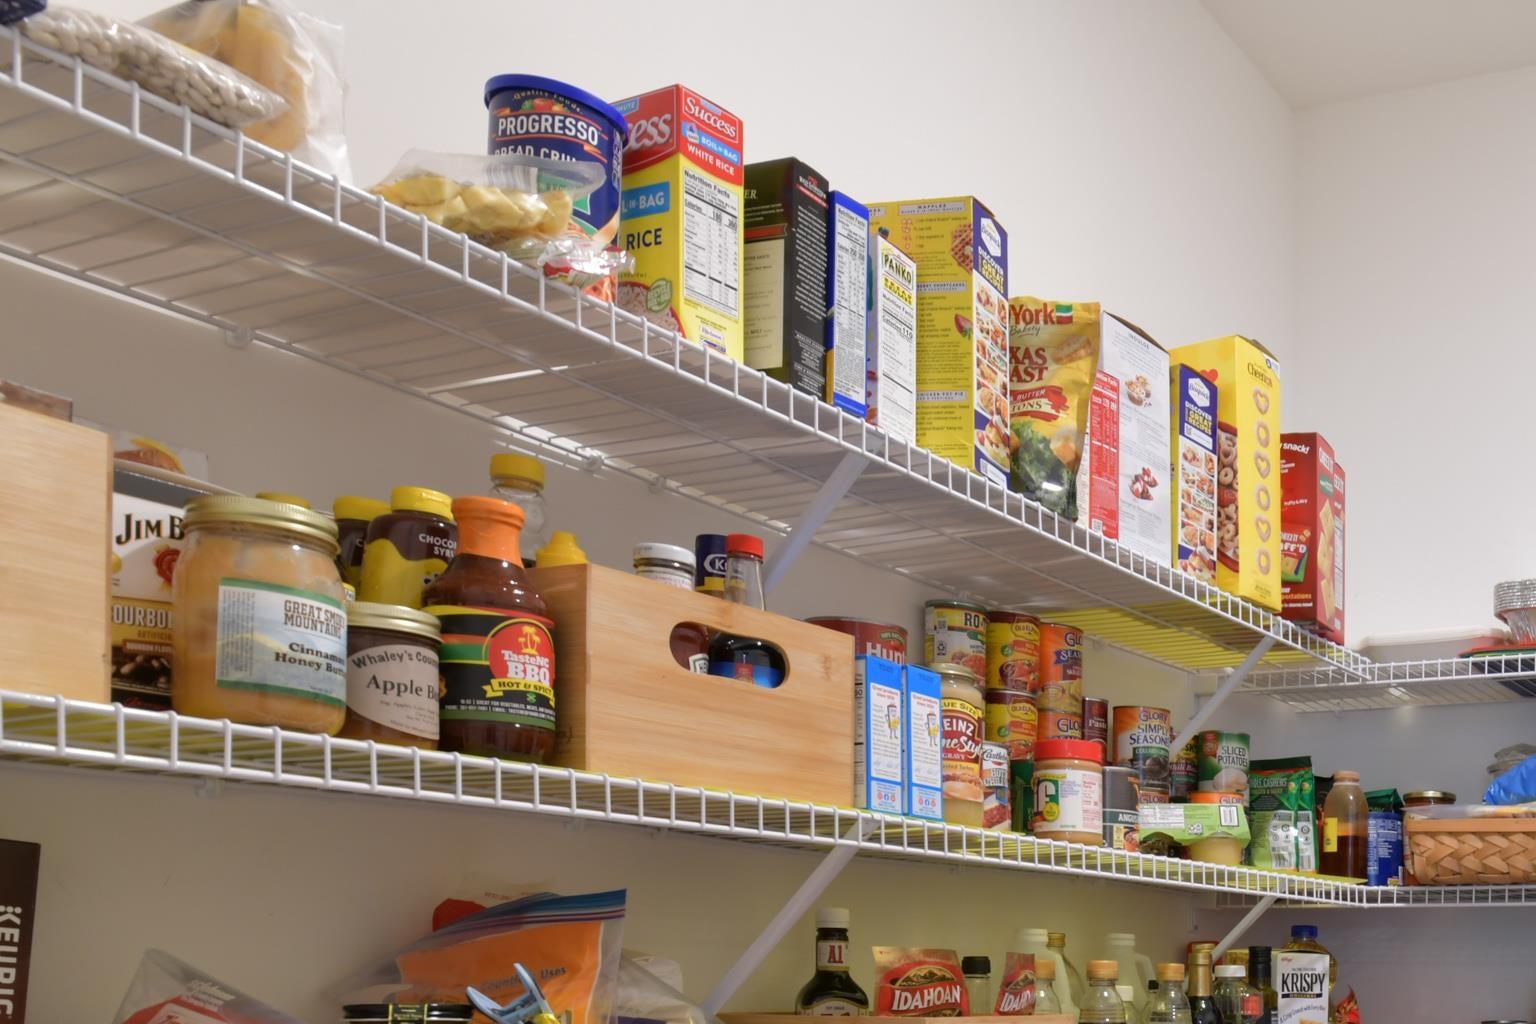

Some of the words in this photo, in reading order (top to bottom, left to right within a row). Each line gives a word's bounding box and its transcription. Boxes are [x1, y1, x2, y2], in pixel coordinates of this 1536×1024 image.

[684, 97, 737, 138] Success
[498, 114, 600, 147] PROGRESSO
[687, 143, 714, 165] WHITE
[715, 157, 735, 176] RICE
[626, 228, 663, 250] RICE
[883, 253, 912, 284] PANKO
[1009, 302, 1056, 326] York
[902, 325, 914, 340] 110
[1016, 389, 1046, 400] BUTTER
[1189, 410, 1212, 427] GREAT
[1283, 442, 1311, 455] snack!
[116, 513, 162, 545] JIM
[418, 533, 458, 550] CHOCO
[112, 603, 173, 628] OURBO
[284, 600, 321, 621] GREAT
[275, 652, 323, 672] Honey
[351, 650, 414, 669] Whaley's
[502, 650, 550, 669] TasteNC
[508, 662, 550, 686] BBQ
[366, 674, 424, 697] Apple
[498, 680, 520, 690] HOT
[1138, 706, 1168, 722] GLORY
[943, 718, 975, 737] EINZ
[1138, 723, 1169, 737] SIMPLY
[1221, 745, 1247, 756] SLICED
[1218, 755, 1248, 768] POTATOES
[540, 967, 567, 980] Uses
[1281, 972, 1326, 993] KRISPY
[892, 984, 961, 1011] IDAHOAN
